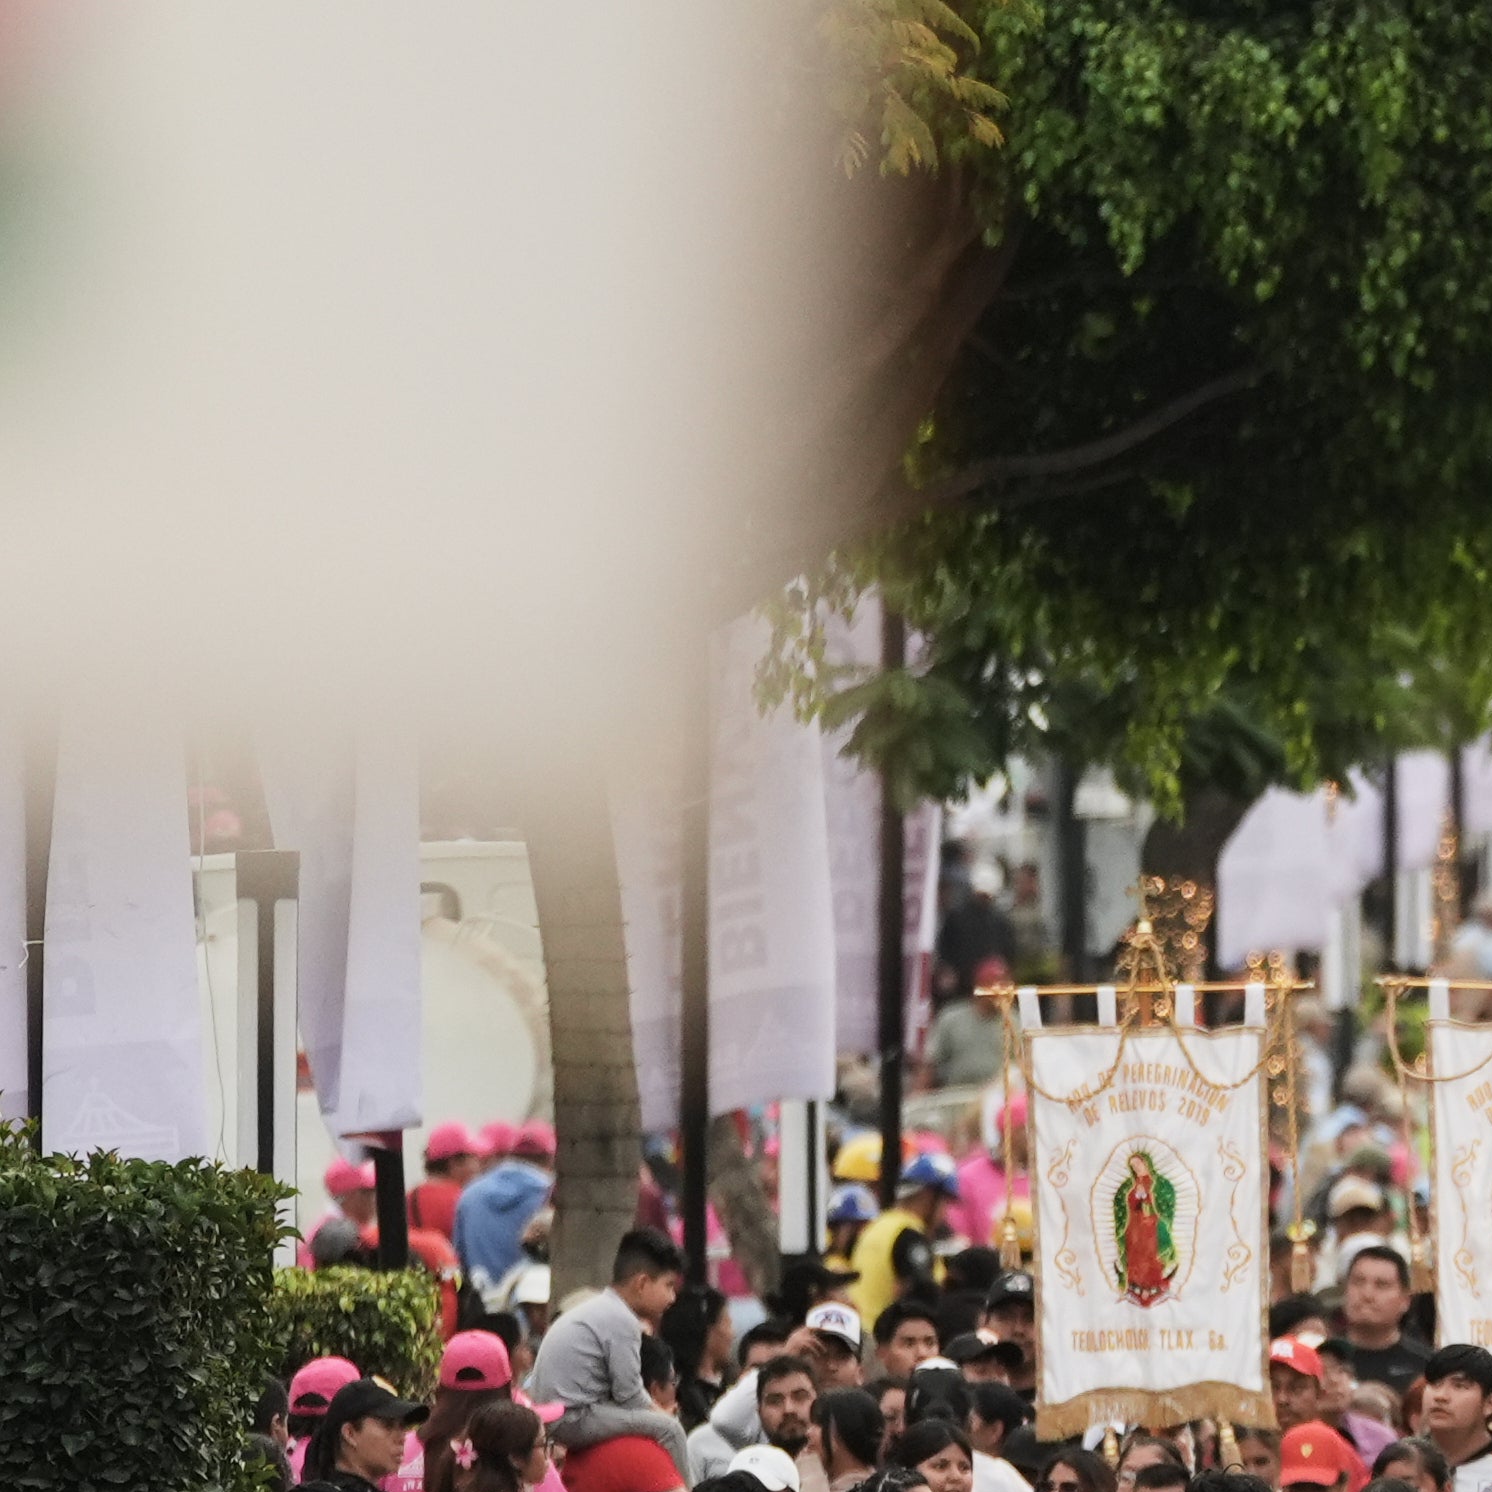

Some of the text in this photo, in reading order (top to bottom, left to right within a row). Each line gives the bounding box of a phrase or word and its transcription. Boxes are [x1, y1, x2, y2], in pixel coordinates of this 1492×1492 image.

[1083, 1088, 1212, 1128] DE RELEVOS 2019
